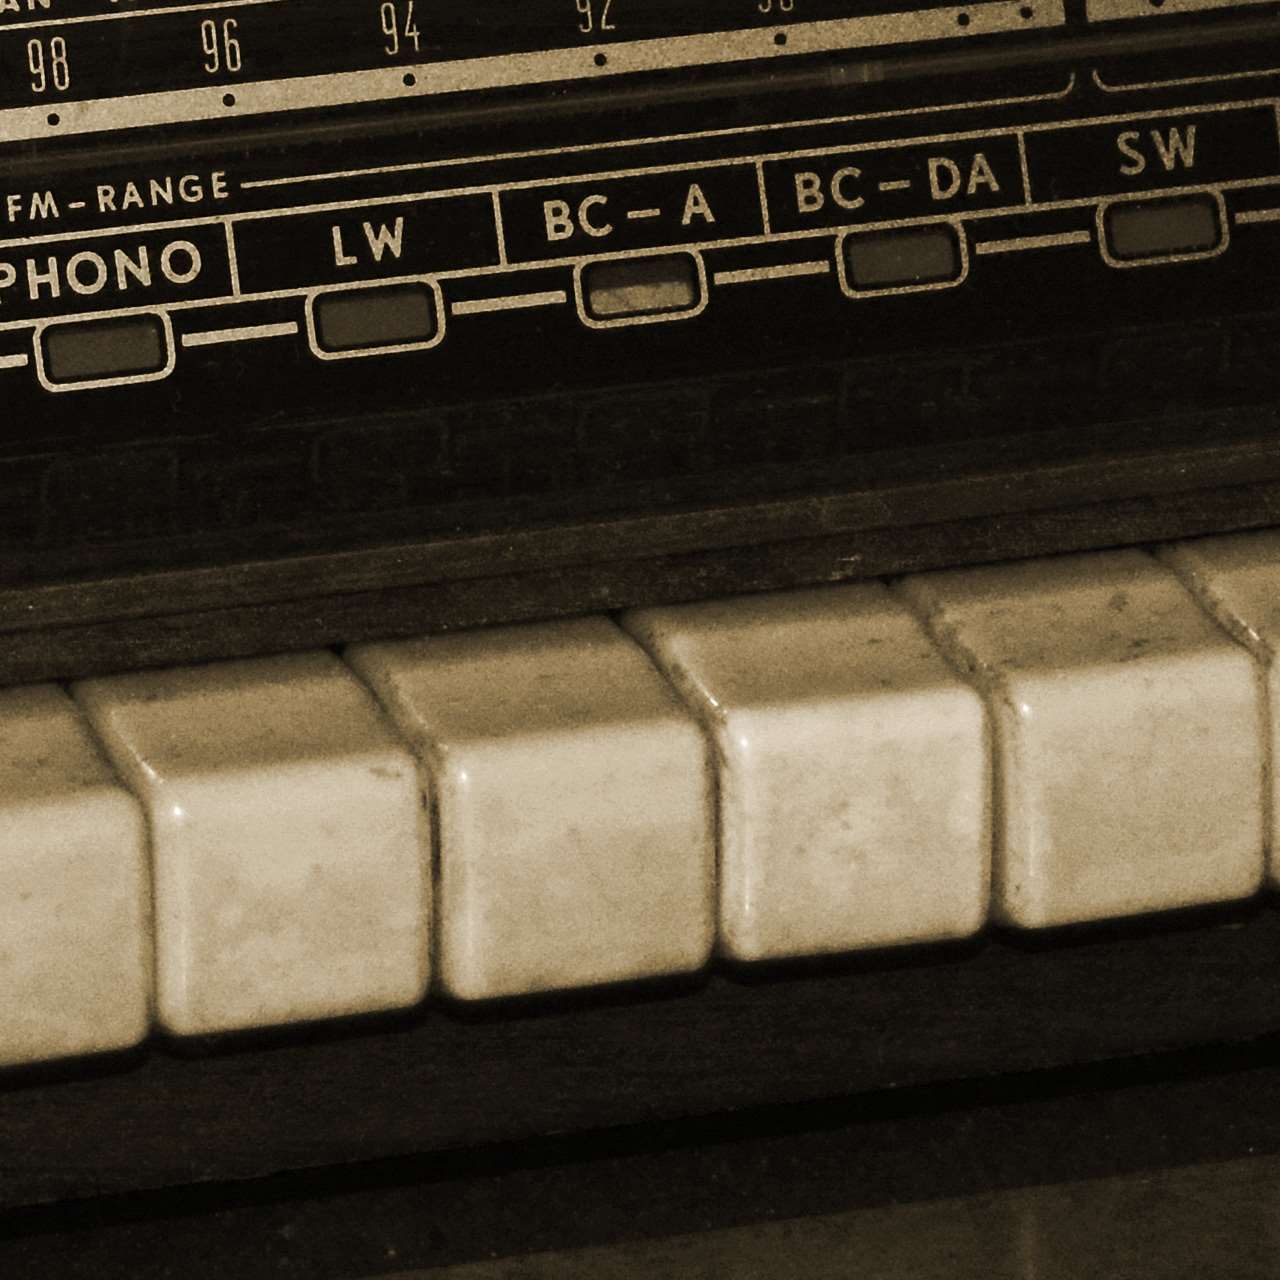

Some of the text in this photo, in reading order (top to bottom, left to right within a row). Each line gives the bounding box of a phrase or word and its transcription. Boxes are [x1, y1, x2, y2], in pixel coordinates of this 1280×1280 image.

[201, 19, 241, 73] 96
[380, 0, 420, 55] 94
[27, 36, 70, 92] 98
[1117, 126, 1196, 175] SW
[332, 217, 403, 266] LW
